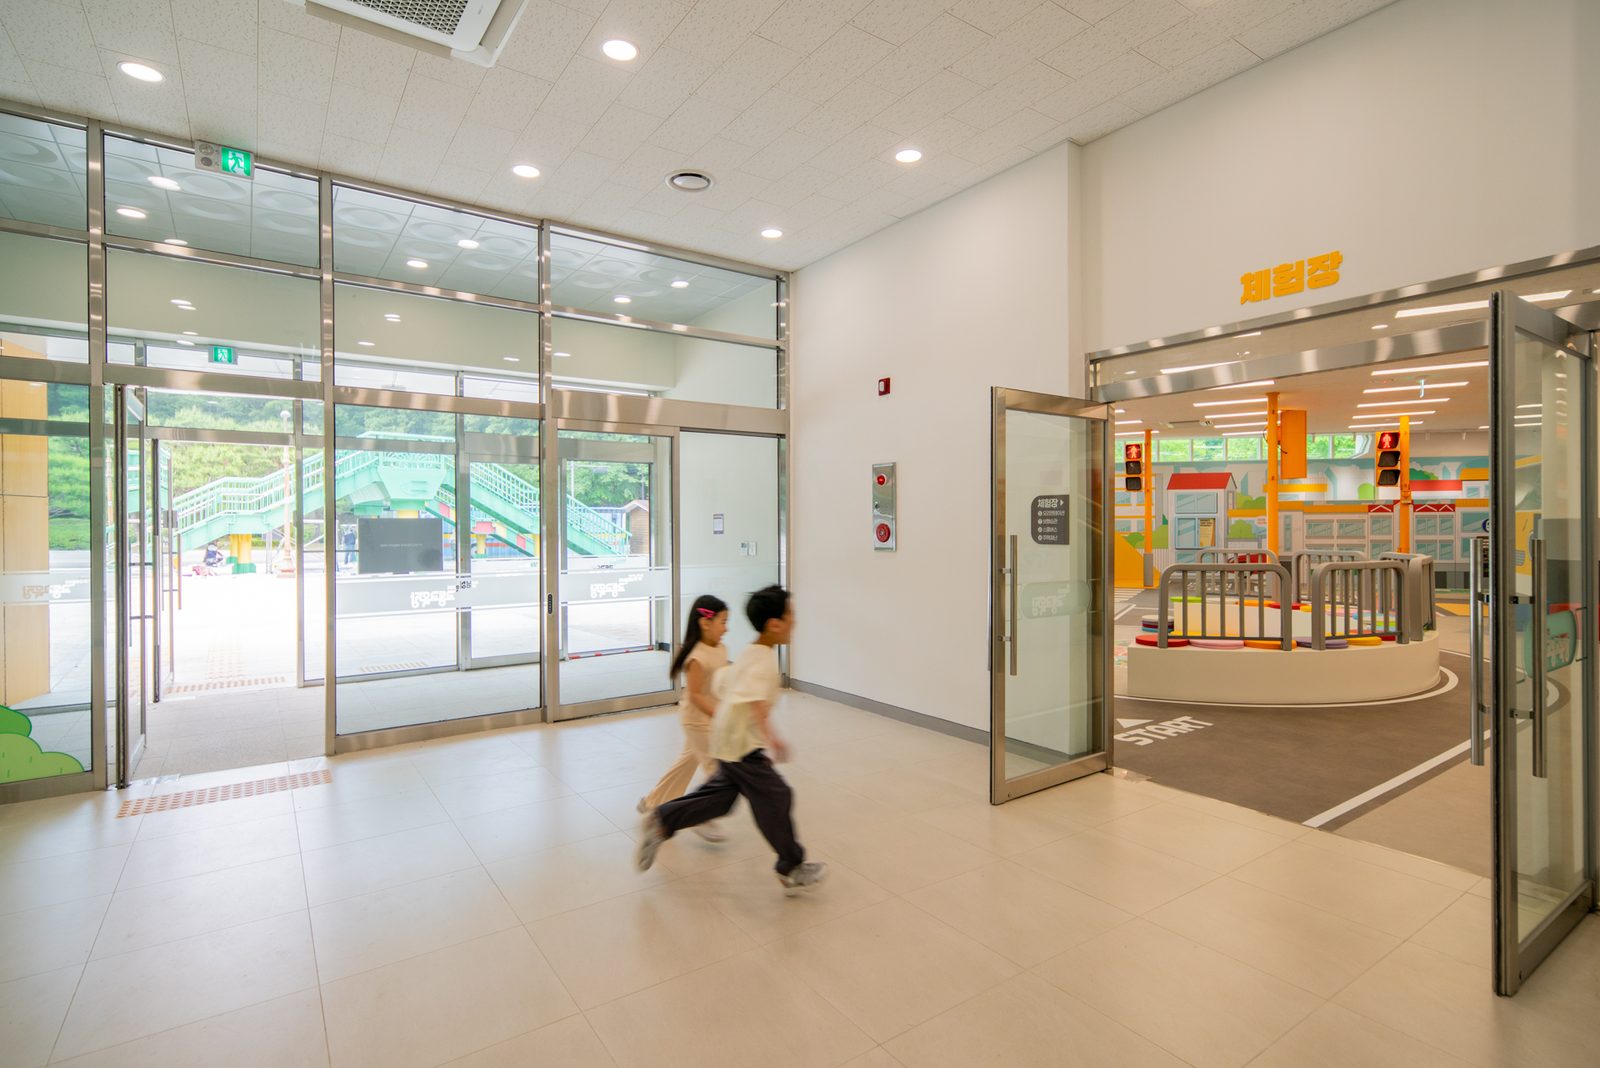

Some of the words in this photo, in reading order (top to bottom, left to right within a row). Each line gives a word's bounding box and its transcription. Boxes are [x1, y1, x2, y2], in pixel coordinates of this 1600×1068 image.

[1240, 250, 1343, 305] 체험장
[1038, 498, 1058, 508] 체험장
[1113, 716, 1214, 745] START
